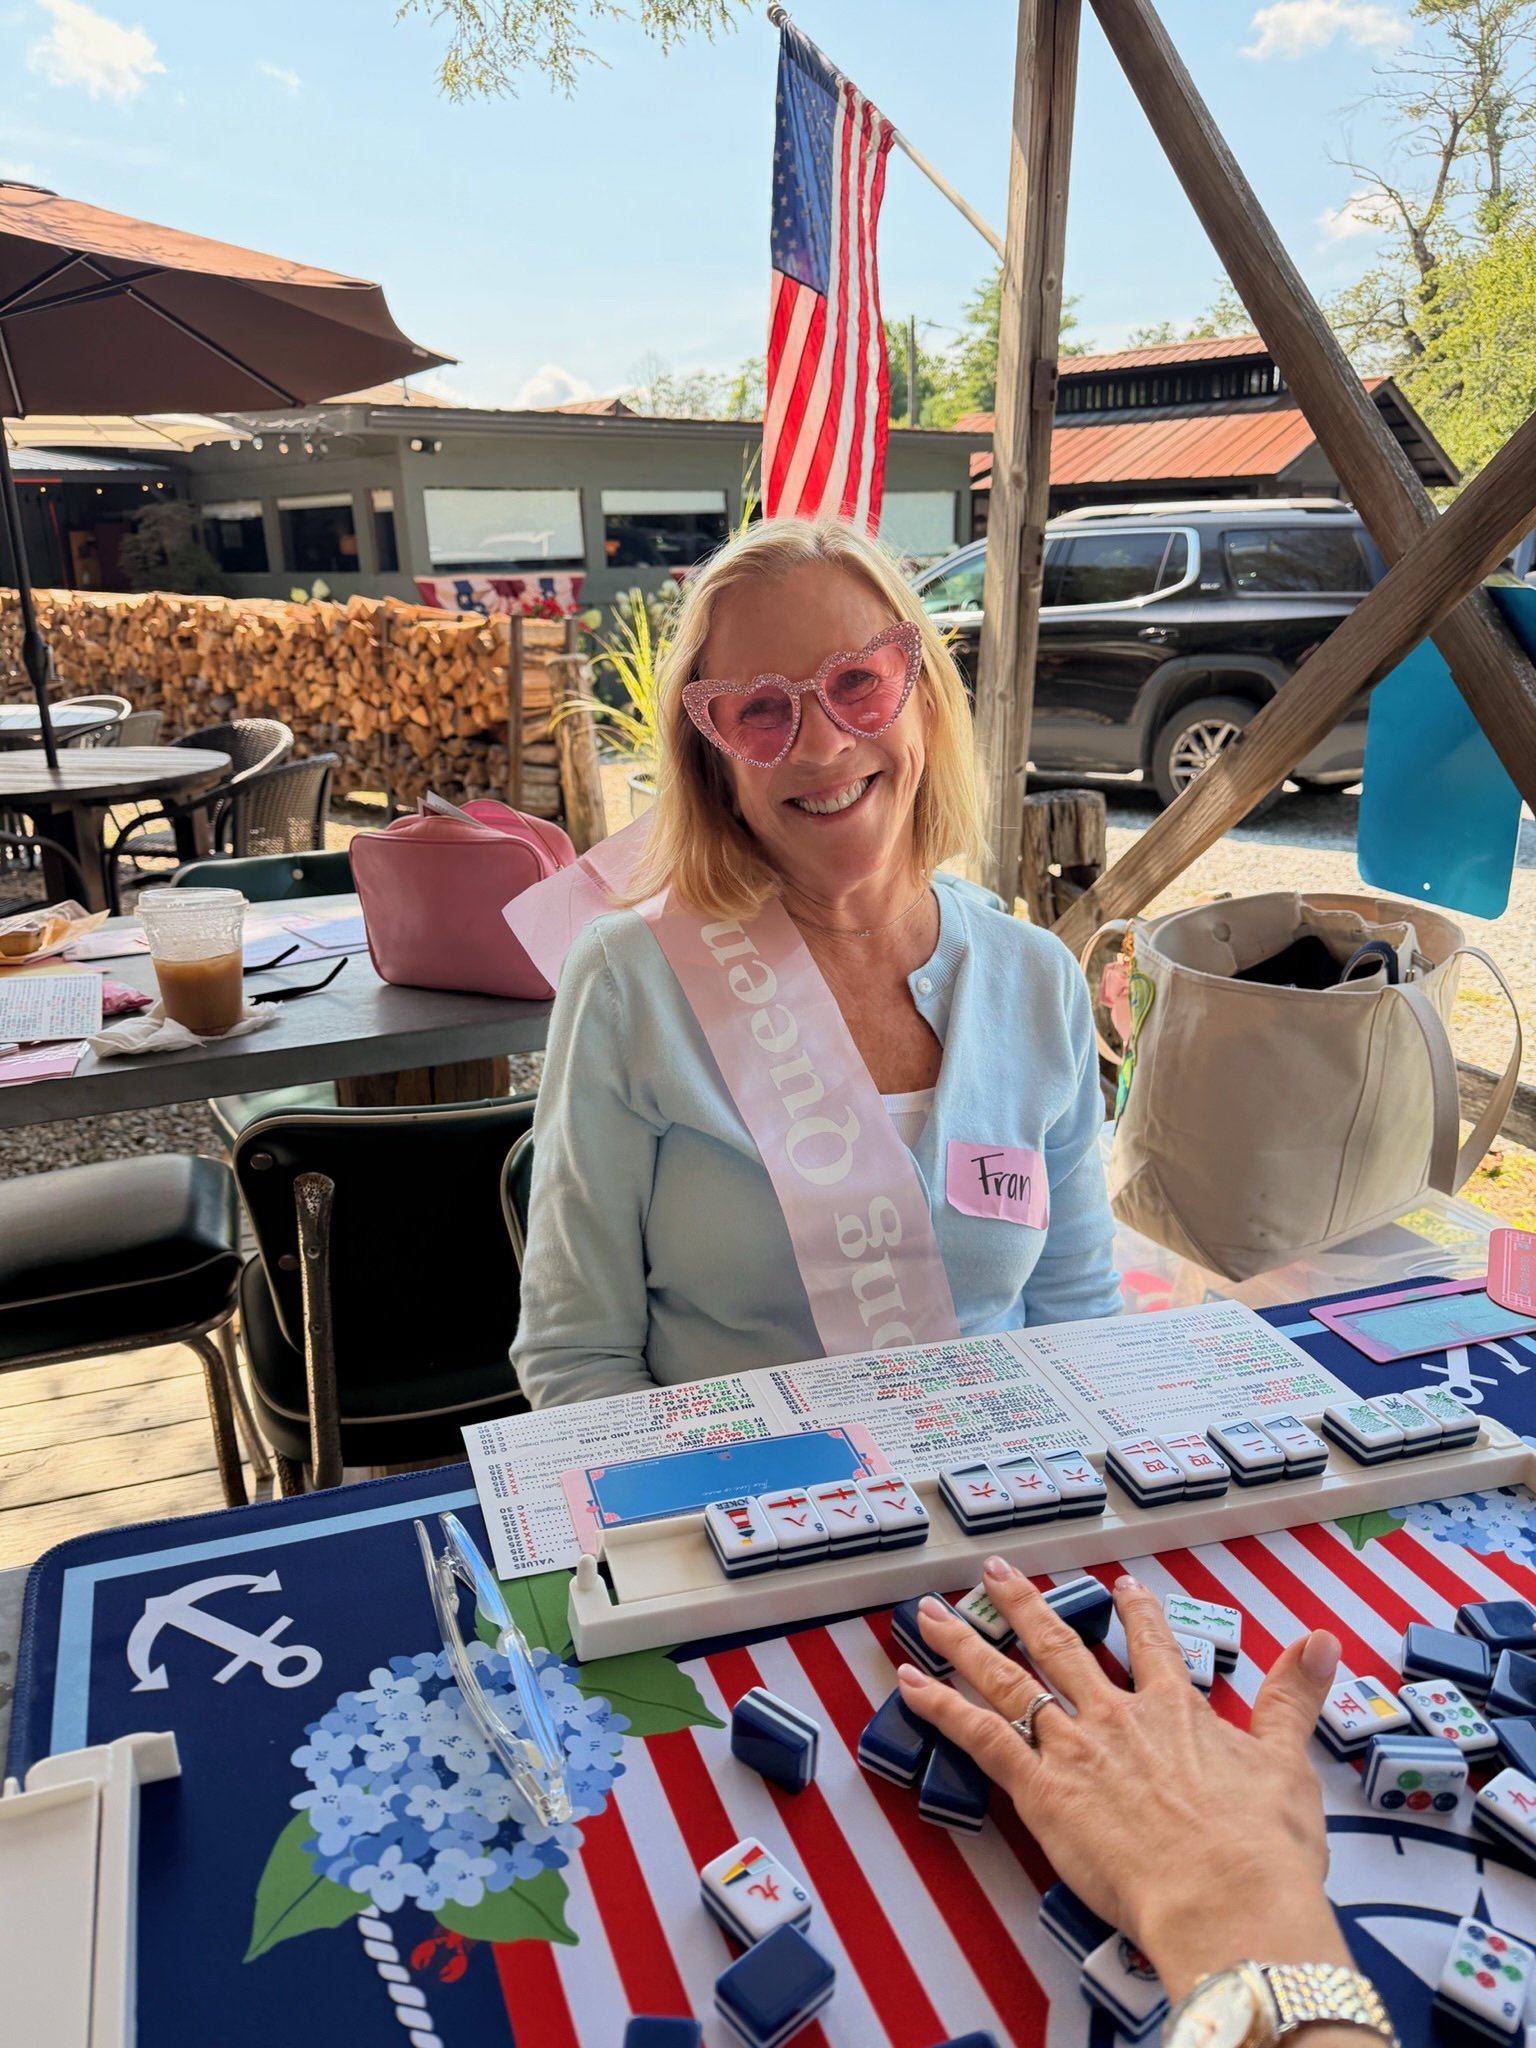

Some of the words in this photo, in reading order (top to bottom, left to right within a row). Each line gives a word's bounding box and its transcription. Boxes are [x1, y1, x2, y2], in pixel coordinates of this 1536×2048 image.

[701, 921, 860, 1185] Queen
[971, 1153, 1032, 1205] Fran
[633, 1423, 672, 1435] SINGLES
[1116, 1427, 1148, 1437] VALUES
[579, 1435, 607, 1445] PAIRS
[610, 1431, 631, 1439] AND
[677, 1439, 704, 1447] NEWS
[932, 1436, 993, 1450] CONSECUTIVE
[1314, 1439, 1326, 1448] 2
[1271, 1445, 1283, 1454] 2
[1216, 1460, 1225, 1470] 4
[1171, 1466, 1181, 1475] 4
[1094, 1477, 1104, 1487] 6
[1046, 1483, 1057, 1494] 6
[1000, 1492, 1010, 1501] 6
[715, 1497, 755, 1511] JOKER
[914, 1506, 925, 1516] 8
[864, 1514, 875, 1524] 8
[814, 1522, 825, 1532] 8
[513, 1557, 554, 1570] VALUES
[1224, 1607, 1238, 1616] 3
[1342, 1720, 1358, 1729] 5
[1450, 1771, 1465, 1779] 5
